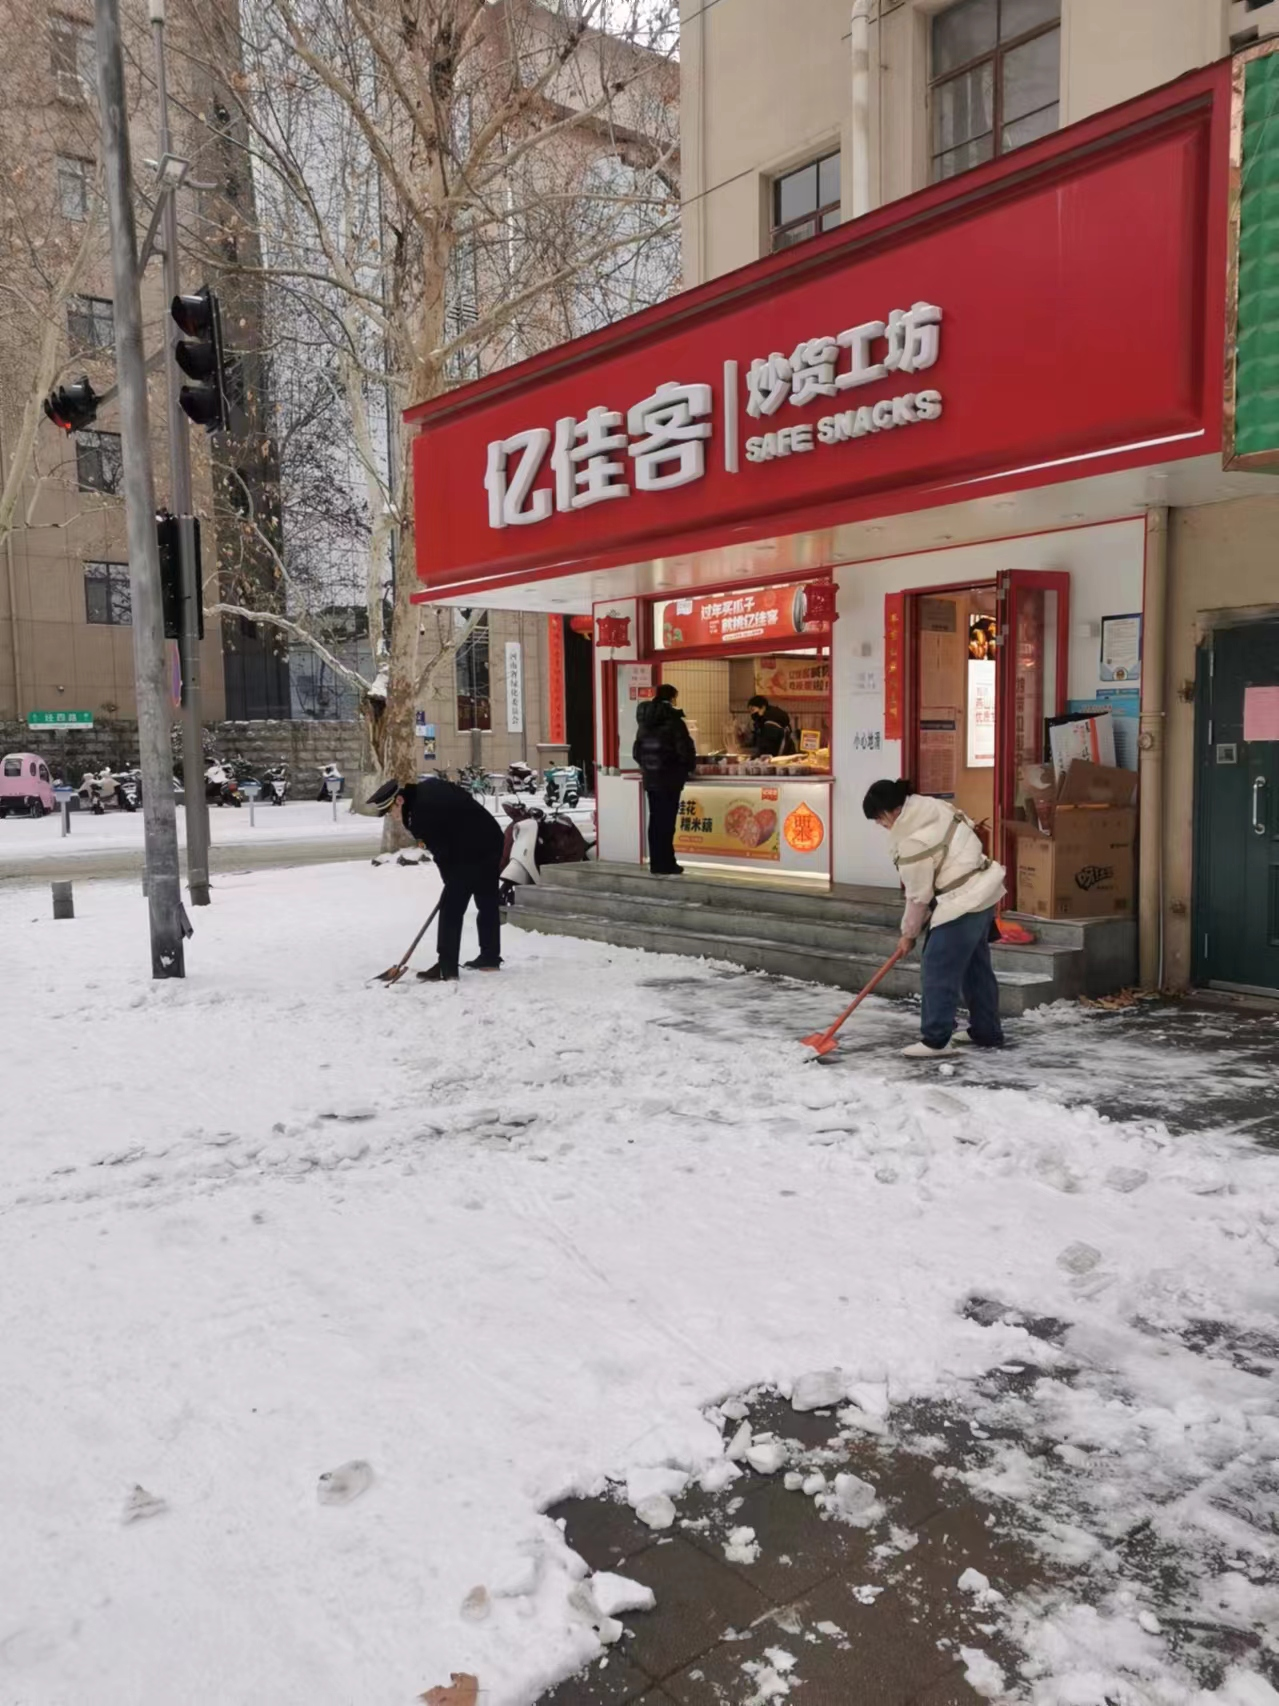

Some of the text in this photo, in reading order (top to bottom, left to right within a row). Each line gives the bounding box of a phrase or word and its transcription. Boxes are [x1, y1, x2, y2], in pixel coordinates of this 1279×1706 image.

[746, 301, 942, 419] 炒货工坊
[485, 382, 712, 528] 亿佳客
[746, 390, 942, 462] SAFE SNACKS
[701, 596, 755, 620] 过年买瓜子
